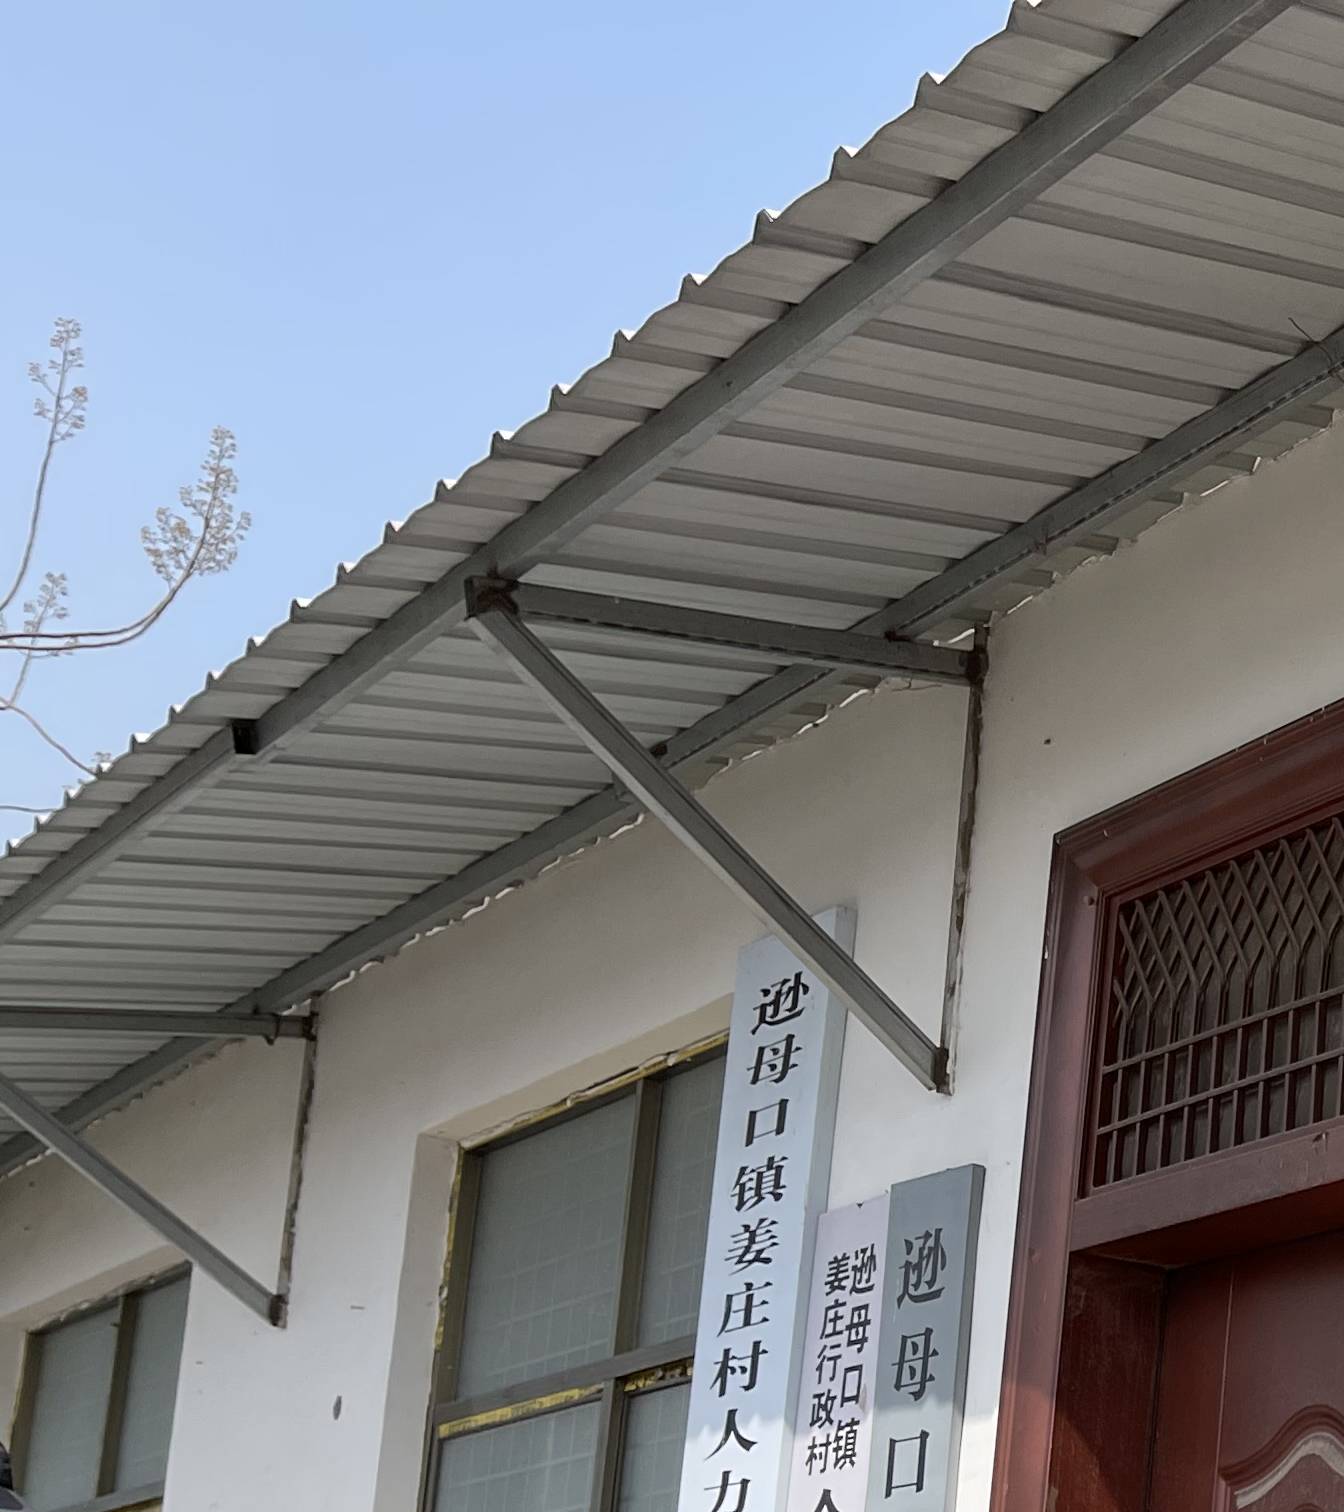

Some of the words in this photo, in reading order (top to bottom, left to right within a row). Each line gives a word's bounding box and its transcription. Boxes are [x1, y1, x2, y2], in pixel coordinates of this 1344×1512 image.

[804, 1253, 850, 1476] 姜庄行政村
[831, 1242, 877, 1473] 逊母口镇
